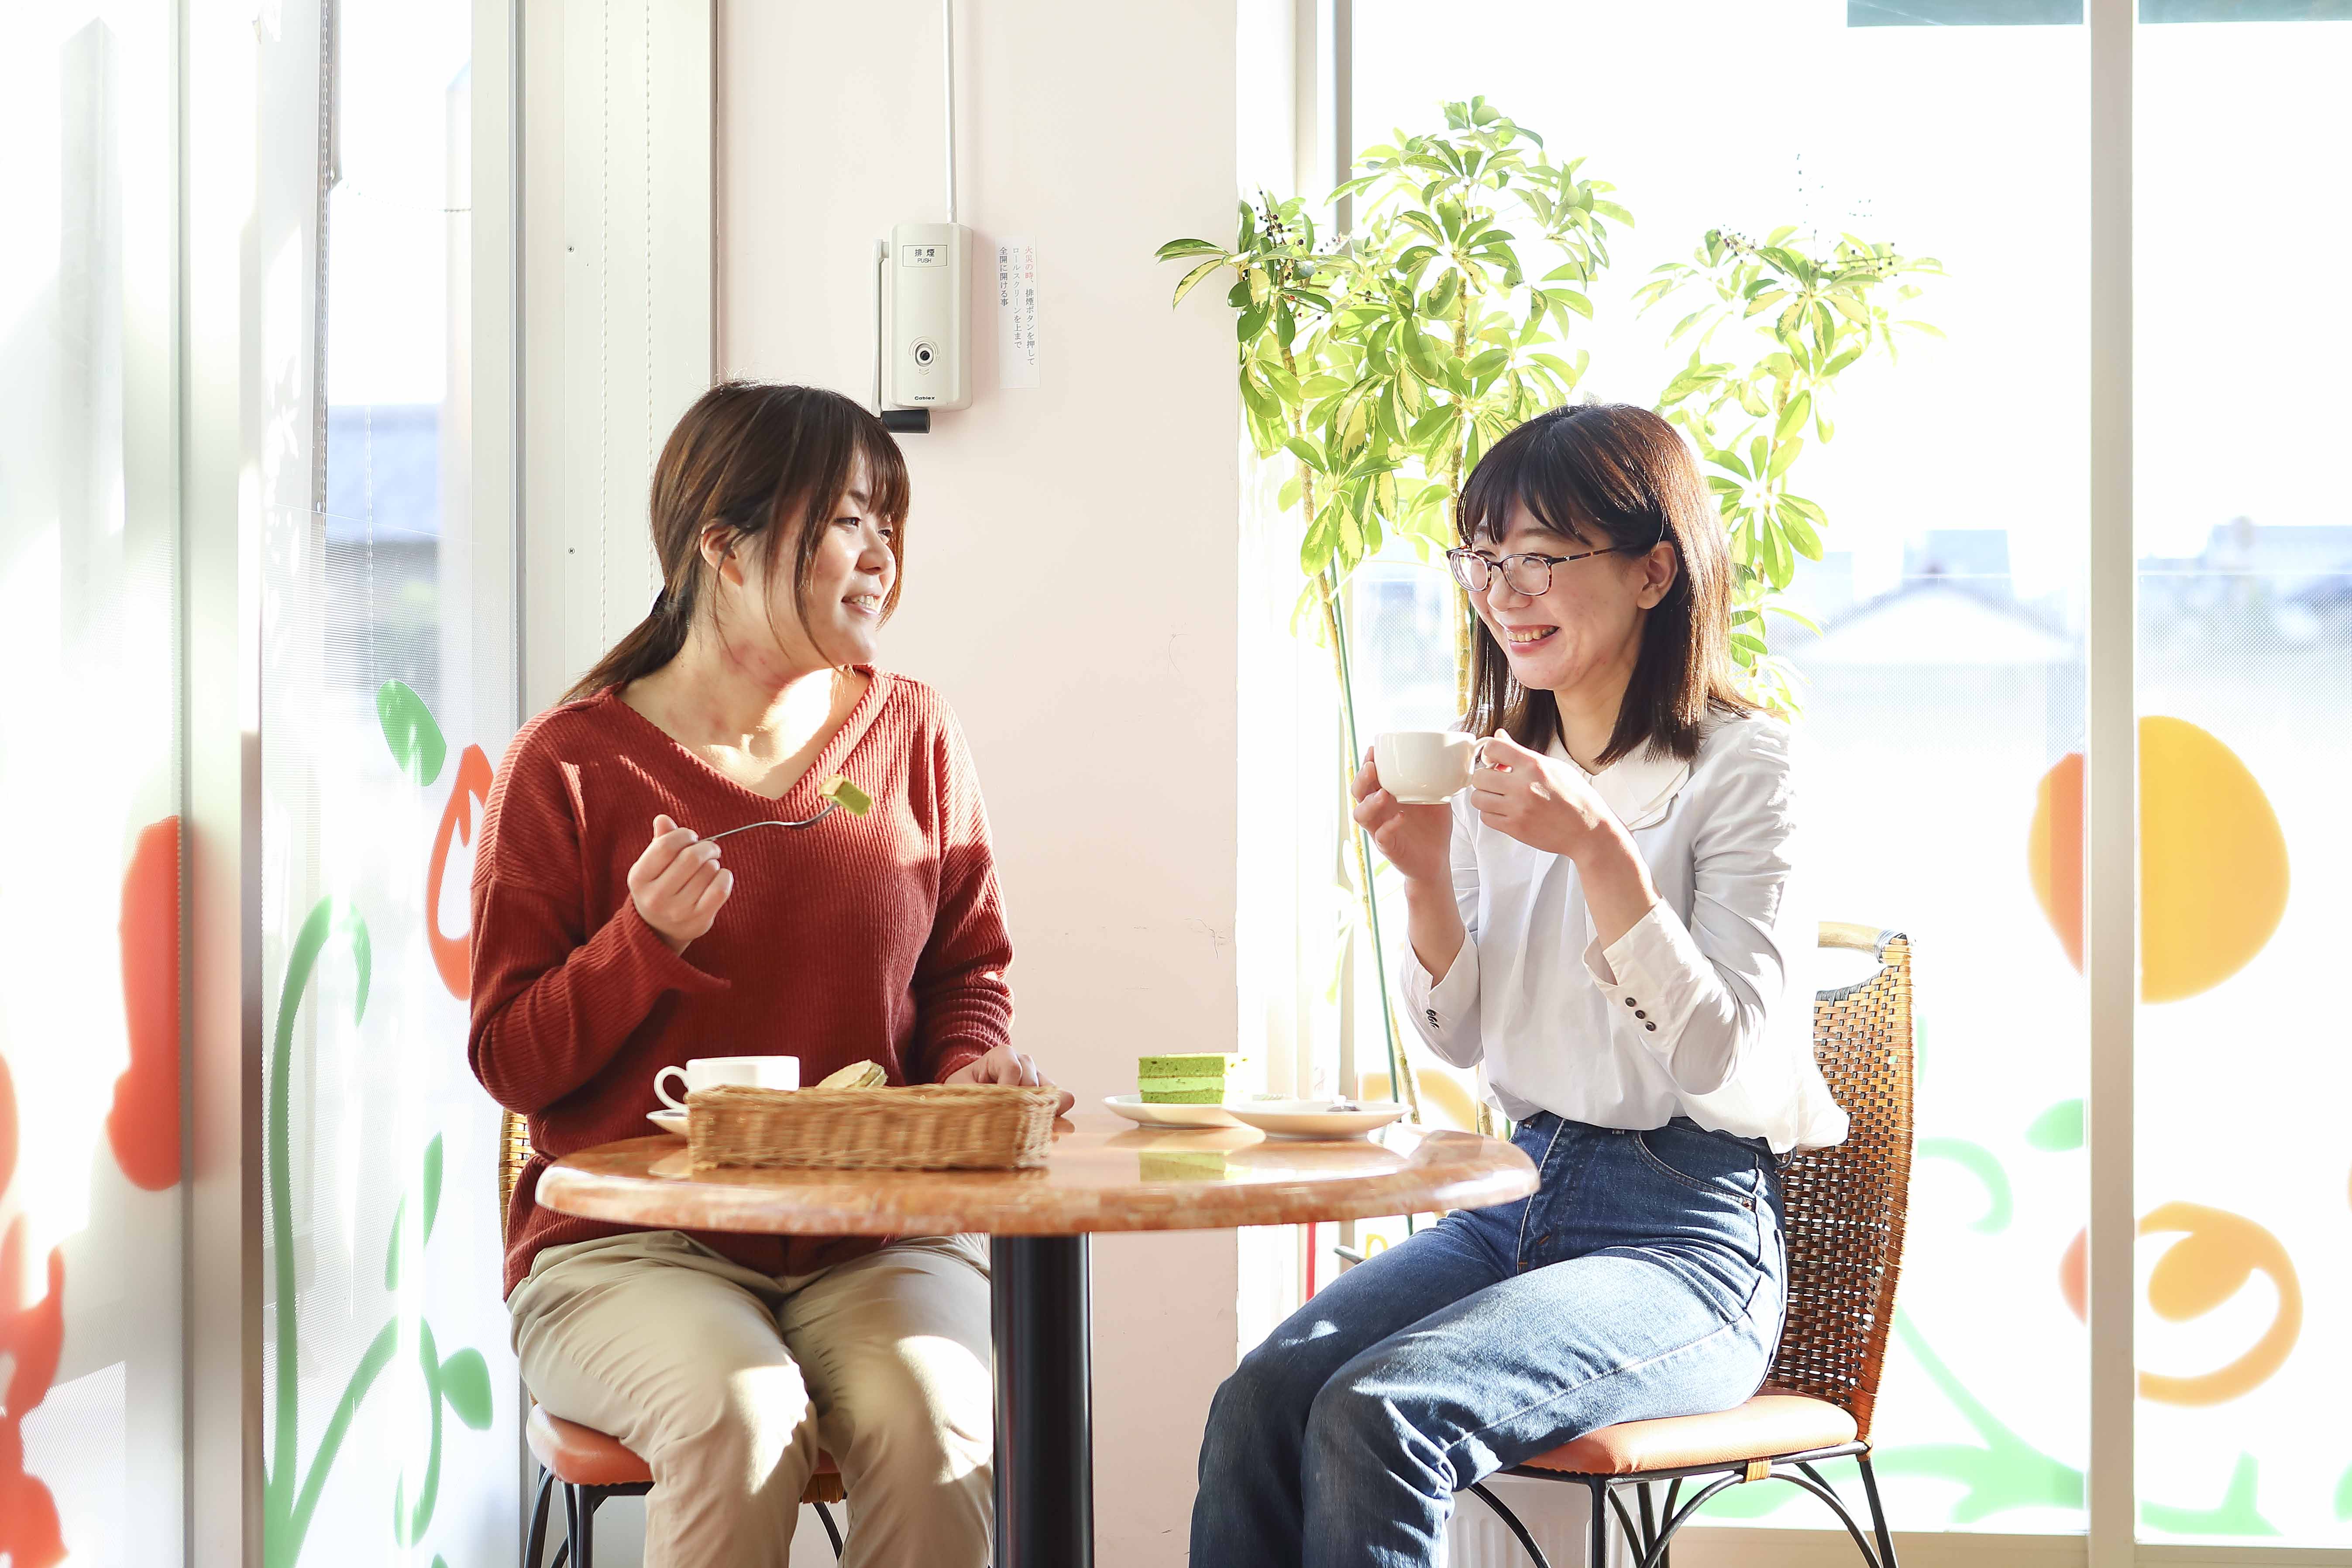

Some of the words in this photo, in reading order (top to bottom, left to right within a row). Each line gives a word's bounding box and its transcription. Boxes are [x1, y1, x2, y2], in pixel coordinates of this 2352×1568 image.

[999, 247, 1009, 306] 全開に開ける事
[1012, 248, 1022, 349] ロールスクリーンを上まで
